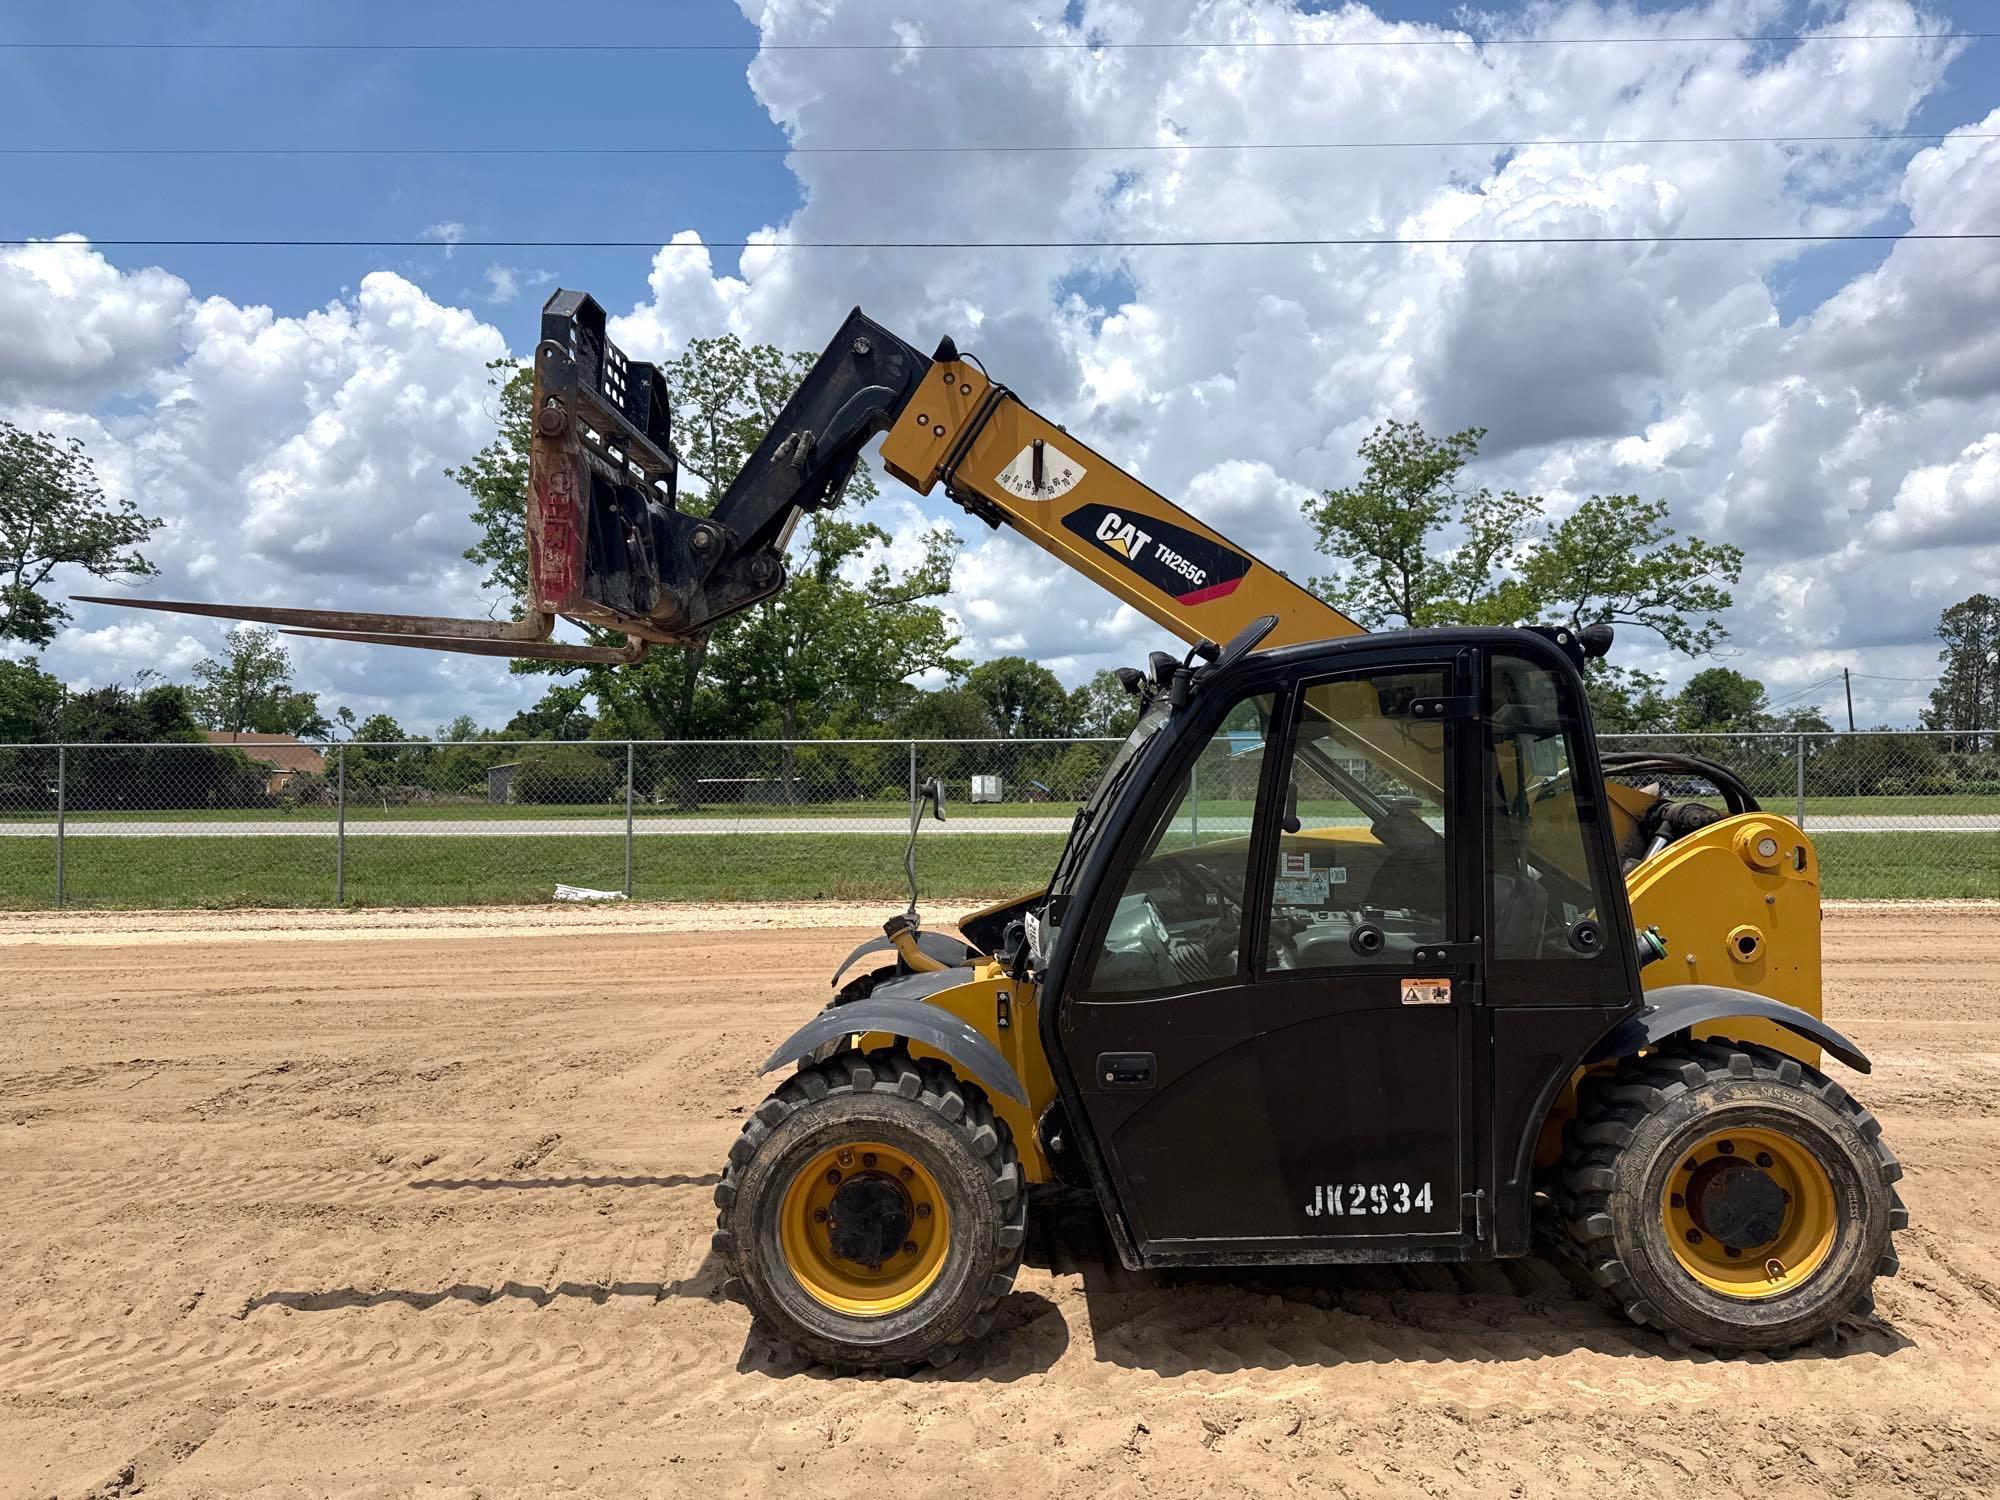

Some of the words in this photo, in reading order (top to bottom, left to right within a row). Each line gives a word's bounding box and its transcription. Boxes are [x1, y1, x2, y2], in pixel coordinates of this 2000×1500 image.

[1016, 483, 1022, 492] 10
[1024, 480, 1032, 488] 20
[1096, 512, 1152, 561] CAT
[1154, 543, 1206, 585] TH255C
[1305, 1182, 1434, 1216] JK2934
